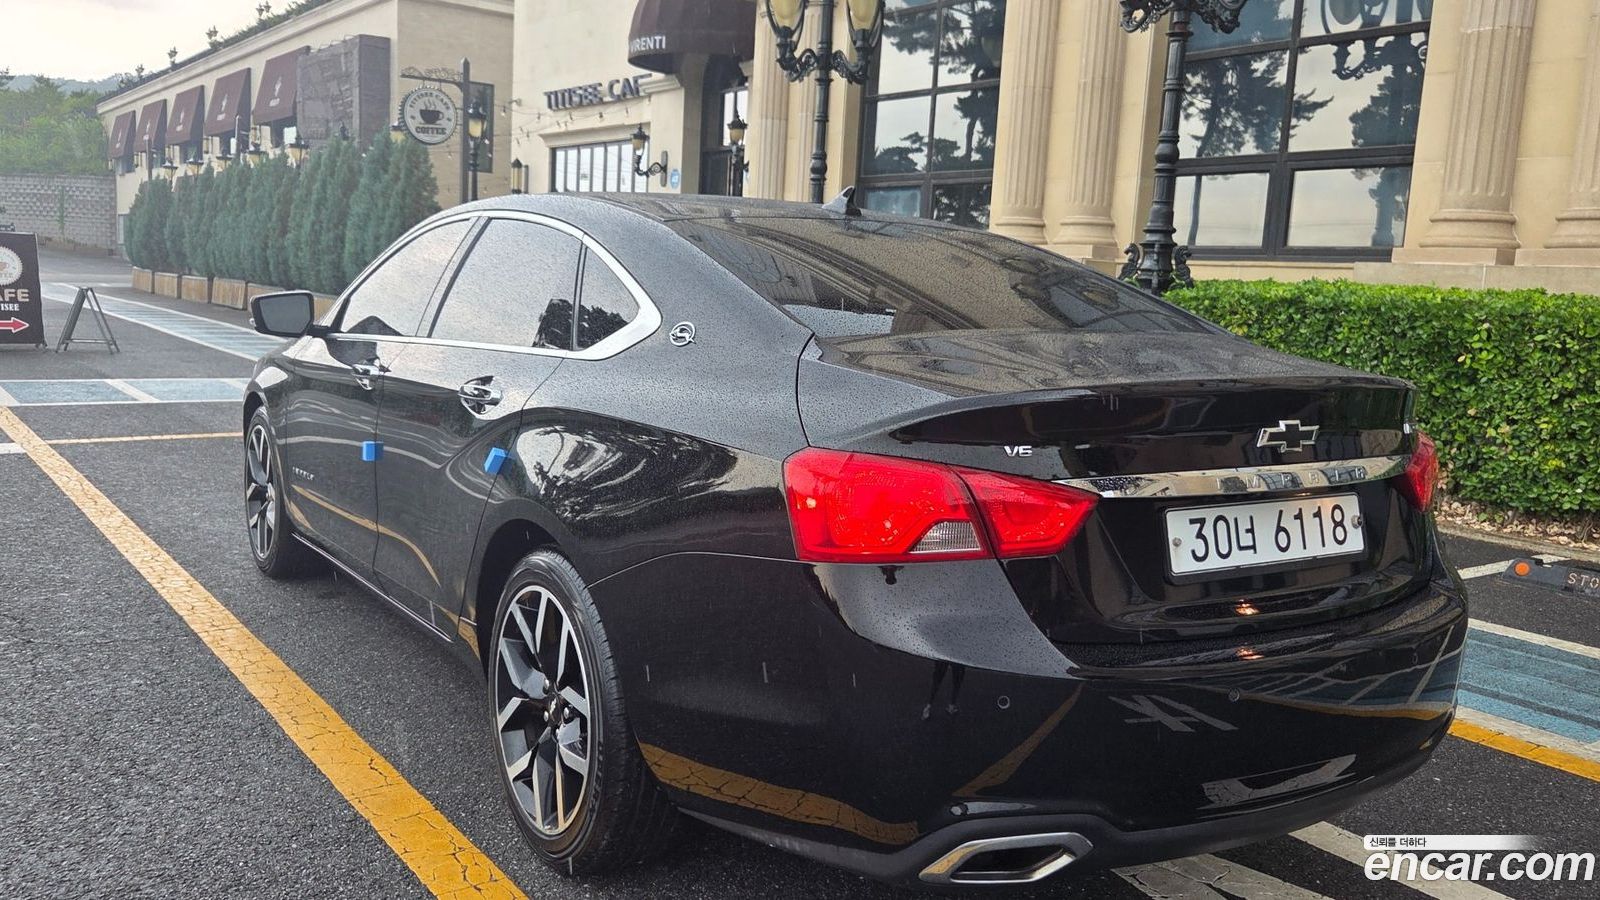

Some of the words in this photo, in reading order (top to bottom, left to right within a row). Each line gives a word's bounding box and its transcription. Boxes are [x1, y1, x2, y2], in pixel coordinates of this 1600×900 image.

[415, 126, 447, 135] COFFEE
[1003, 445, 1033, 457] V6
[1189, 514, 1257, 563] 30너
[1274, 503, 1348, 553] 6118
